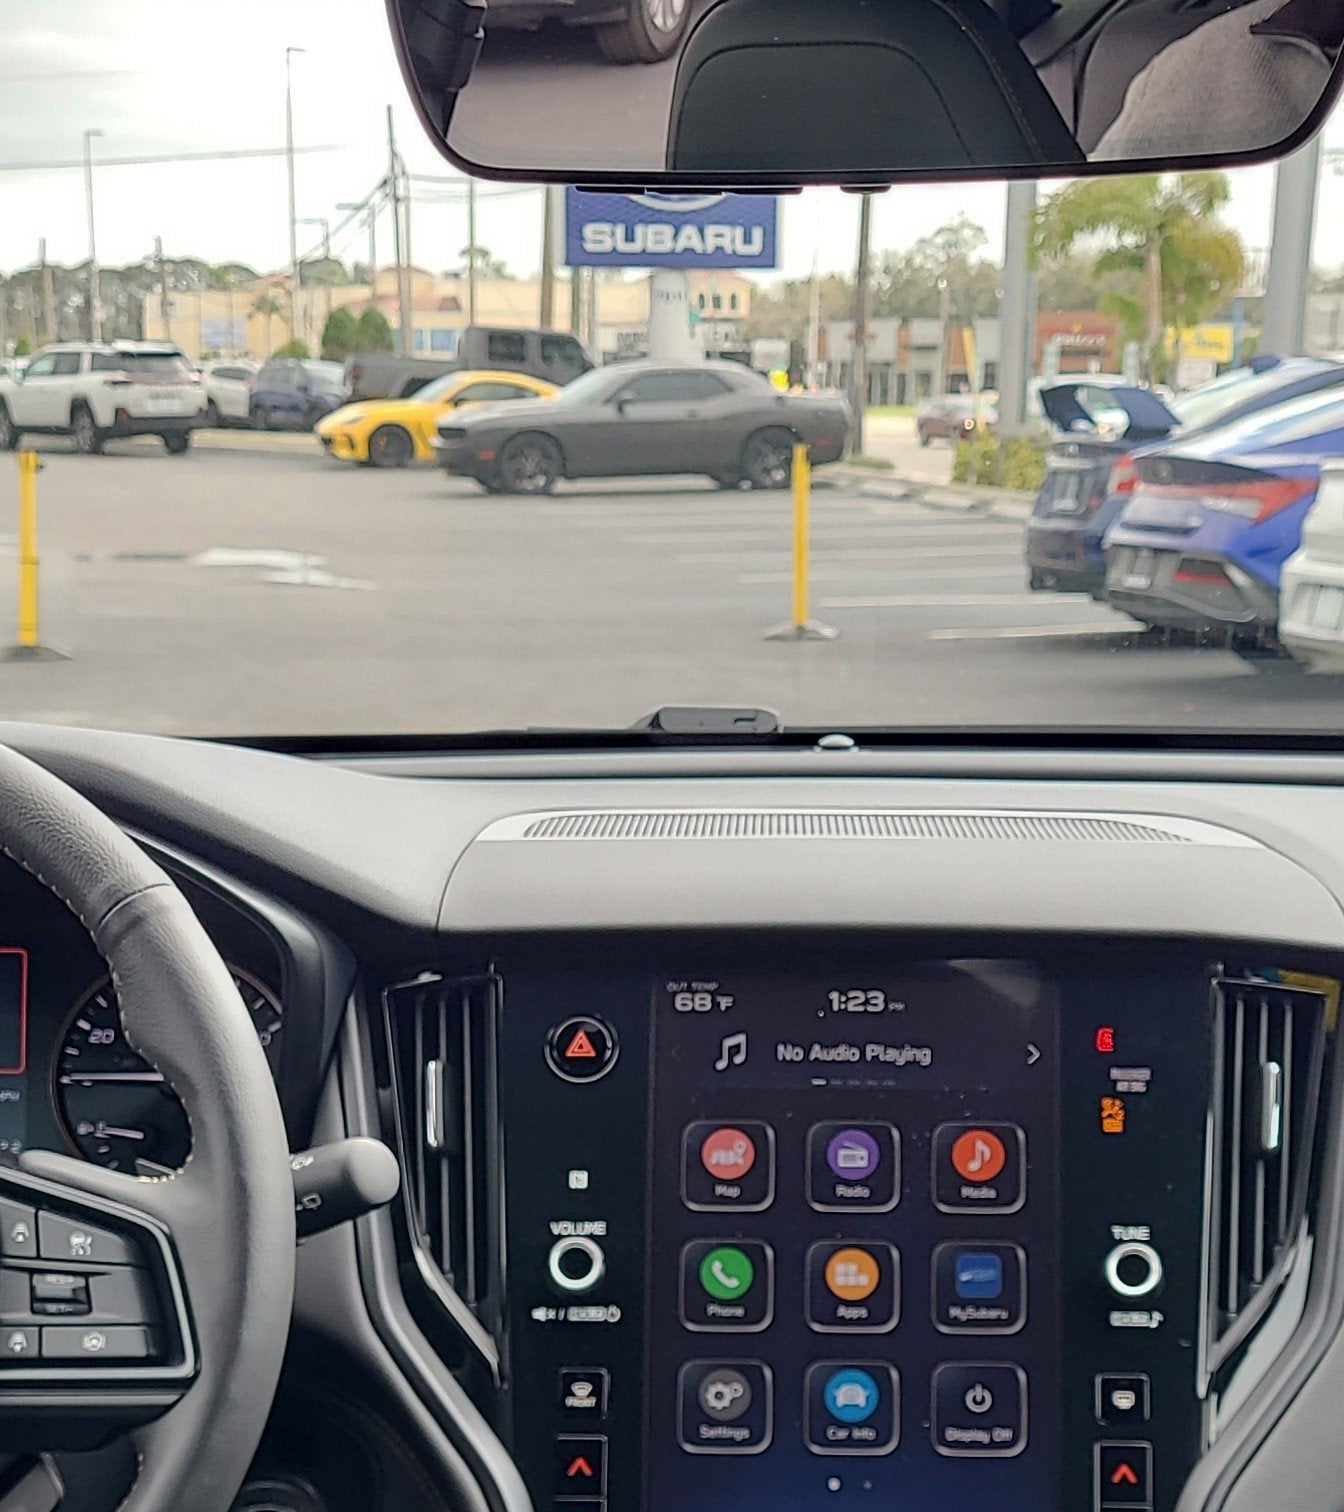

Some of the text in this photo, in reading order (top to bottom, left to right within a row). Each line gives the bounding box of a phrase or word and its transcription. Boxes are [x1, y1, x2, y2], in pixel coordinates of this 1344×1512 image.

[582, 221, 764, 256] SUBARU
[674, 992, 713, 1012] 68
[828, 990, 886, 1013] 1:23
[776, 1043, 932, 1066] No Audio Playing
[550, 1221, 607, 1236] VOLUME
[1110, 1225, 1151, 1241] TUNE
[706, 1304, 745, 1318] Phone
[698, 1423, 751, 1442] Settings
[826, 1426, 851, 1441] Car
